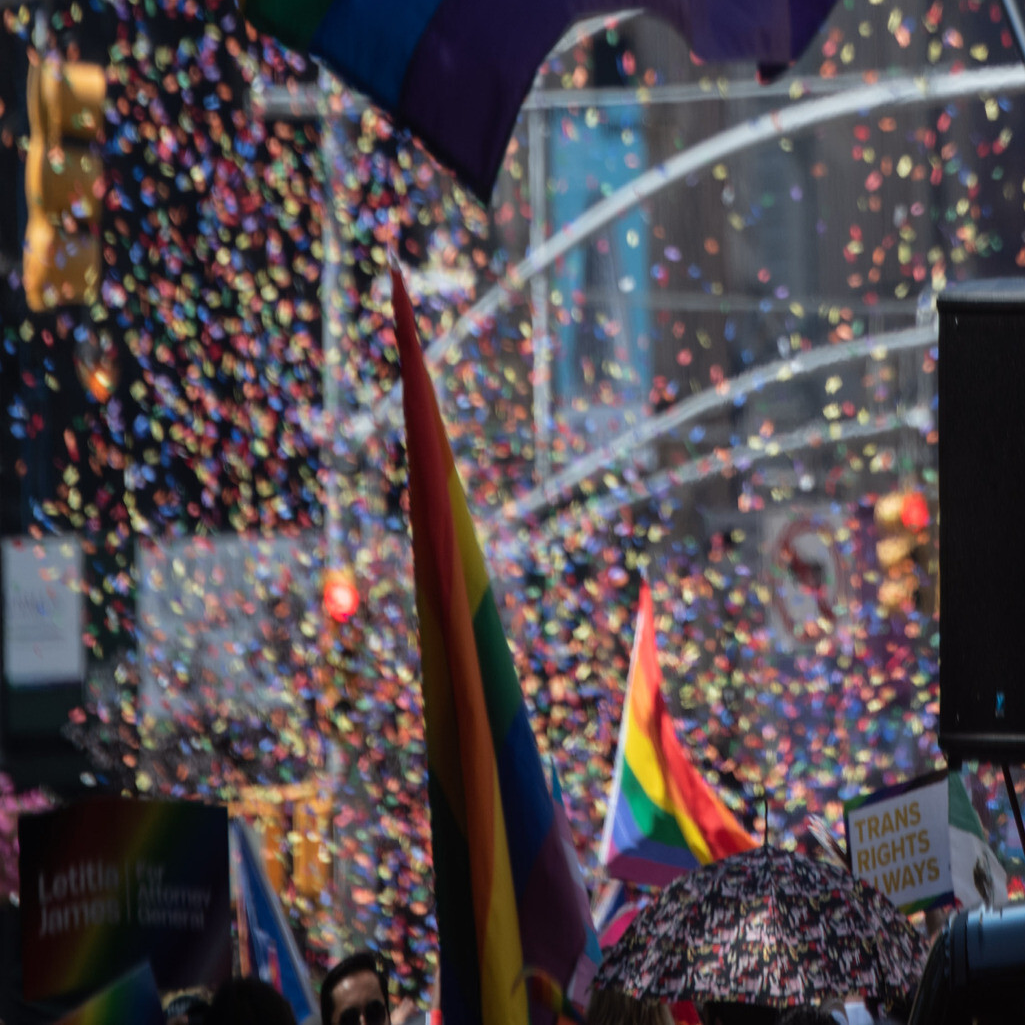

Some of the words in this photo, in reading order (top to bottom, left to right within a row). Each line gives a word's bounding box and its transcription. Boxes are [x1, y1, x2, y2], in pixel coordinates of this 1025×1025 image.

[854, 801, 921, 843] TRANS
[857, 829, 930, 874] RIGHTS
[38, 859, 120, 904] Letitia
[137, 880, 212, 909] Attorney
[873, 857, 940, 895] LWAYS
[39, 898, 120, 938] James
[137, 906, 205, 930] General
